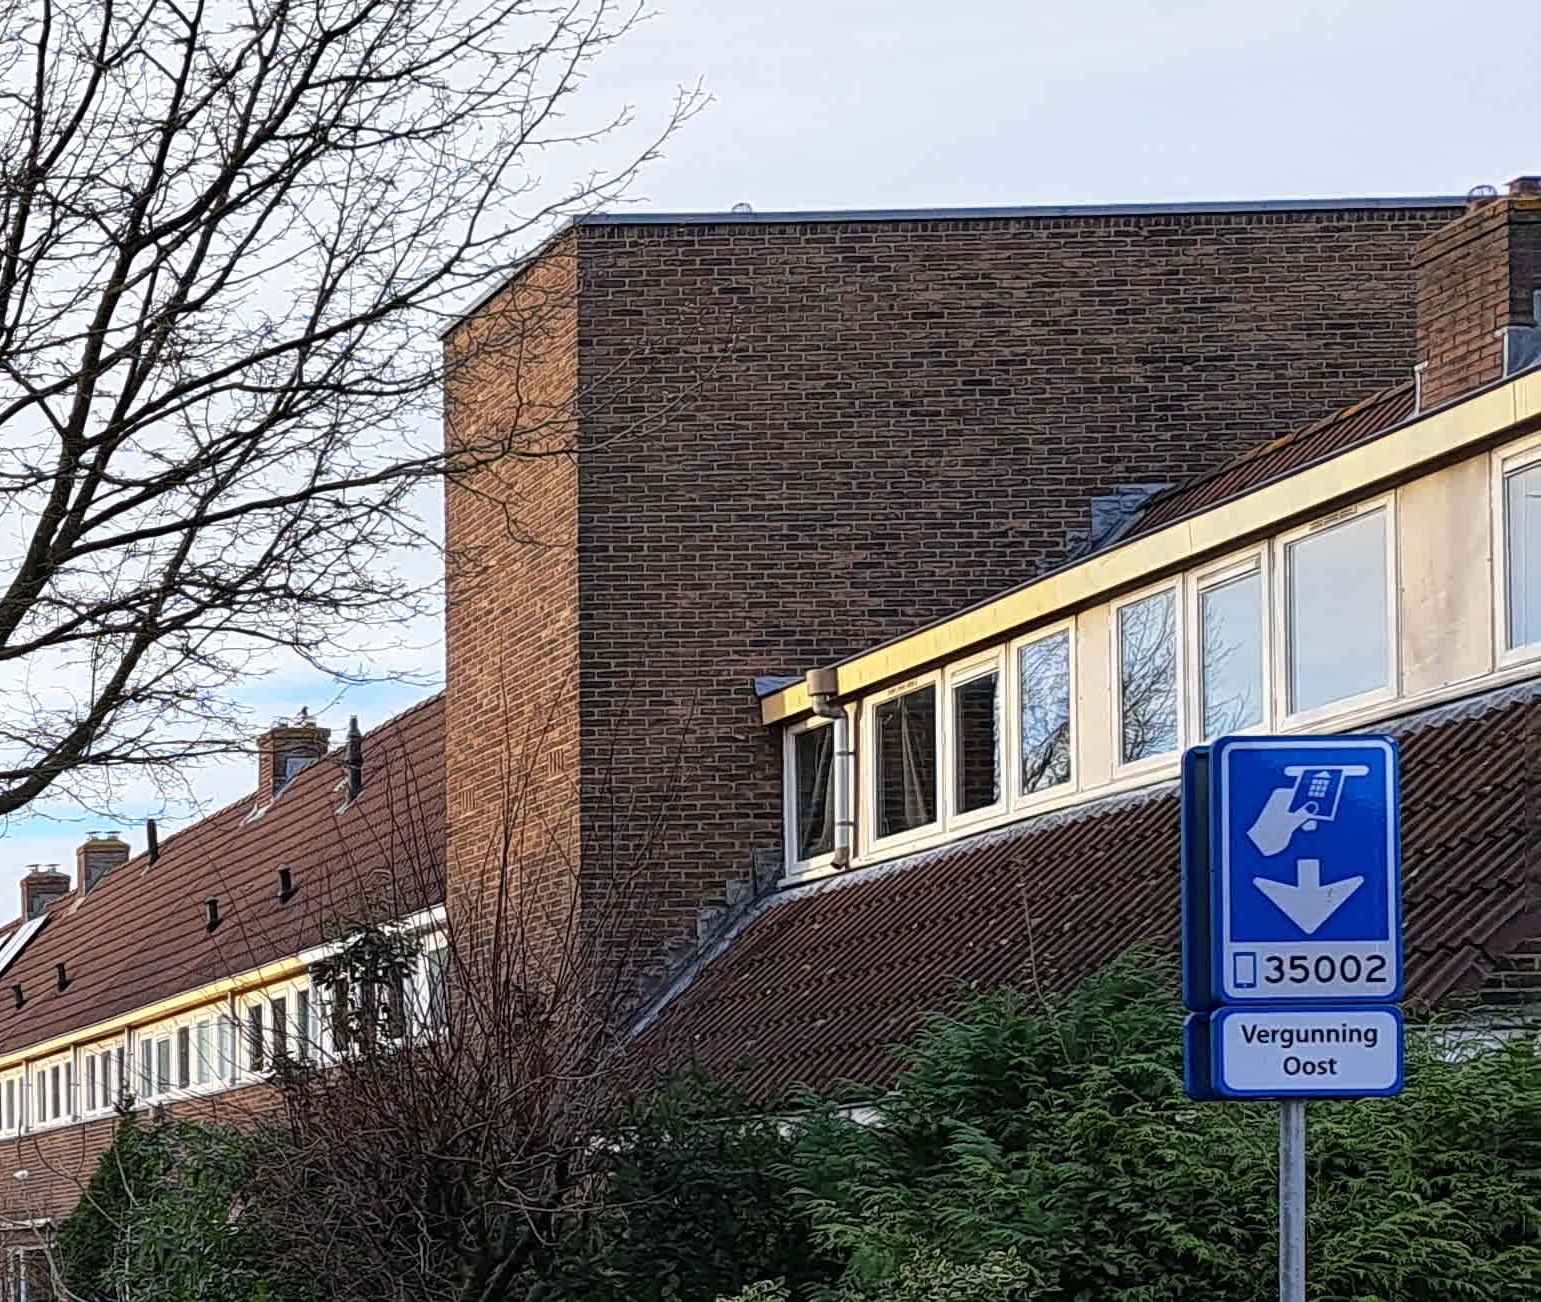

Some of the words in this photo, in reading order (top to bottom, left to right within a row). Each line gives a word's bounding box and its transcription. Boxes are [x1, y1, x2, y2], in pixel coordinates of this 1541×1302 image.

[1264, 954, 1387, 984] 35002
[1240, 1023, 1378, 1049] Vergunning
[1283, 1056, 1337, 1076] Oost
